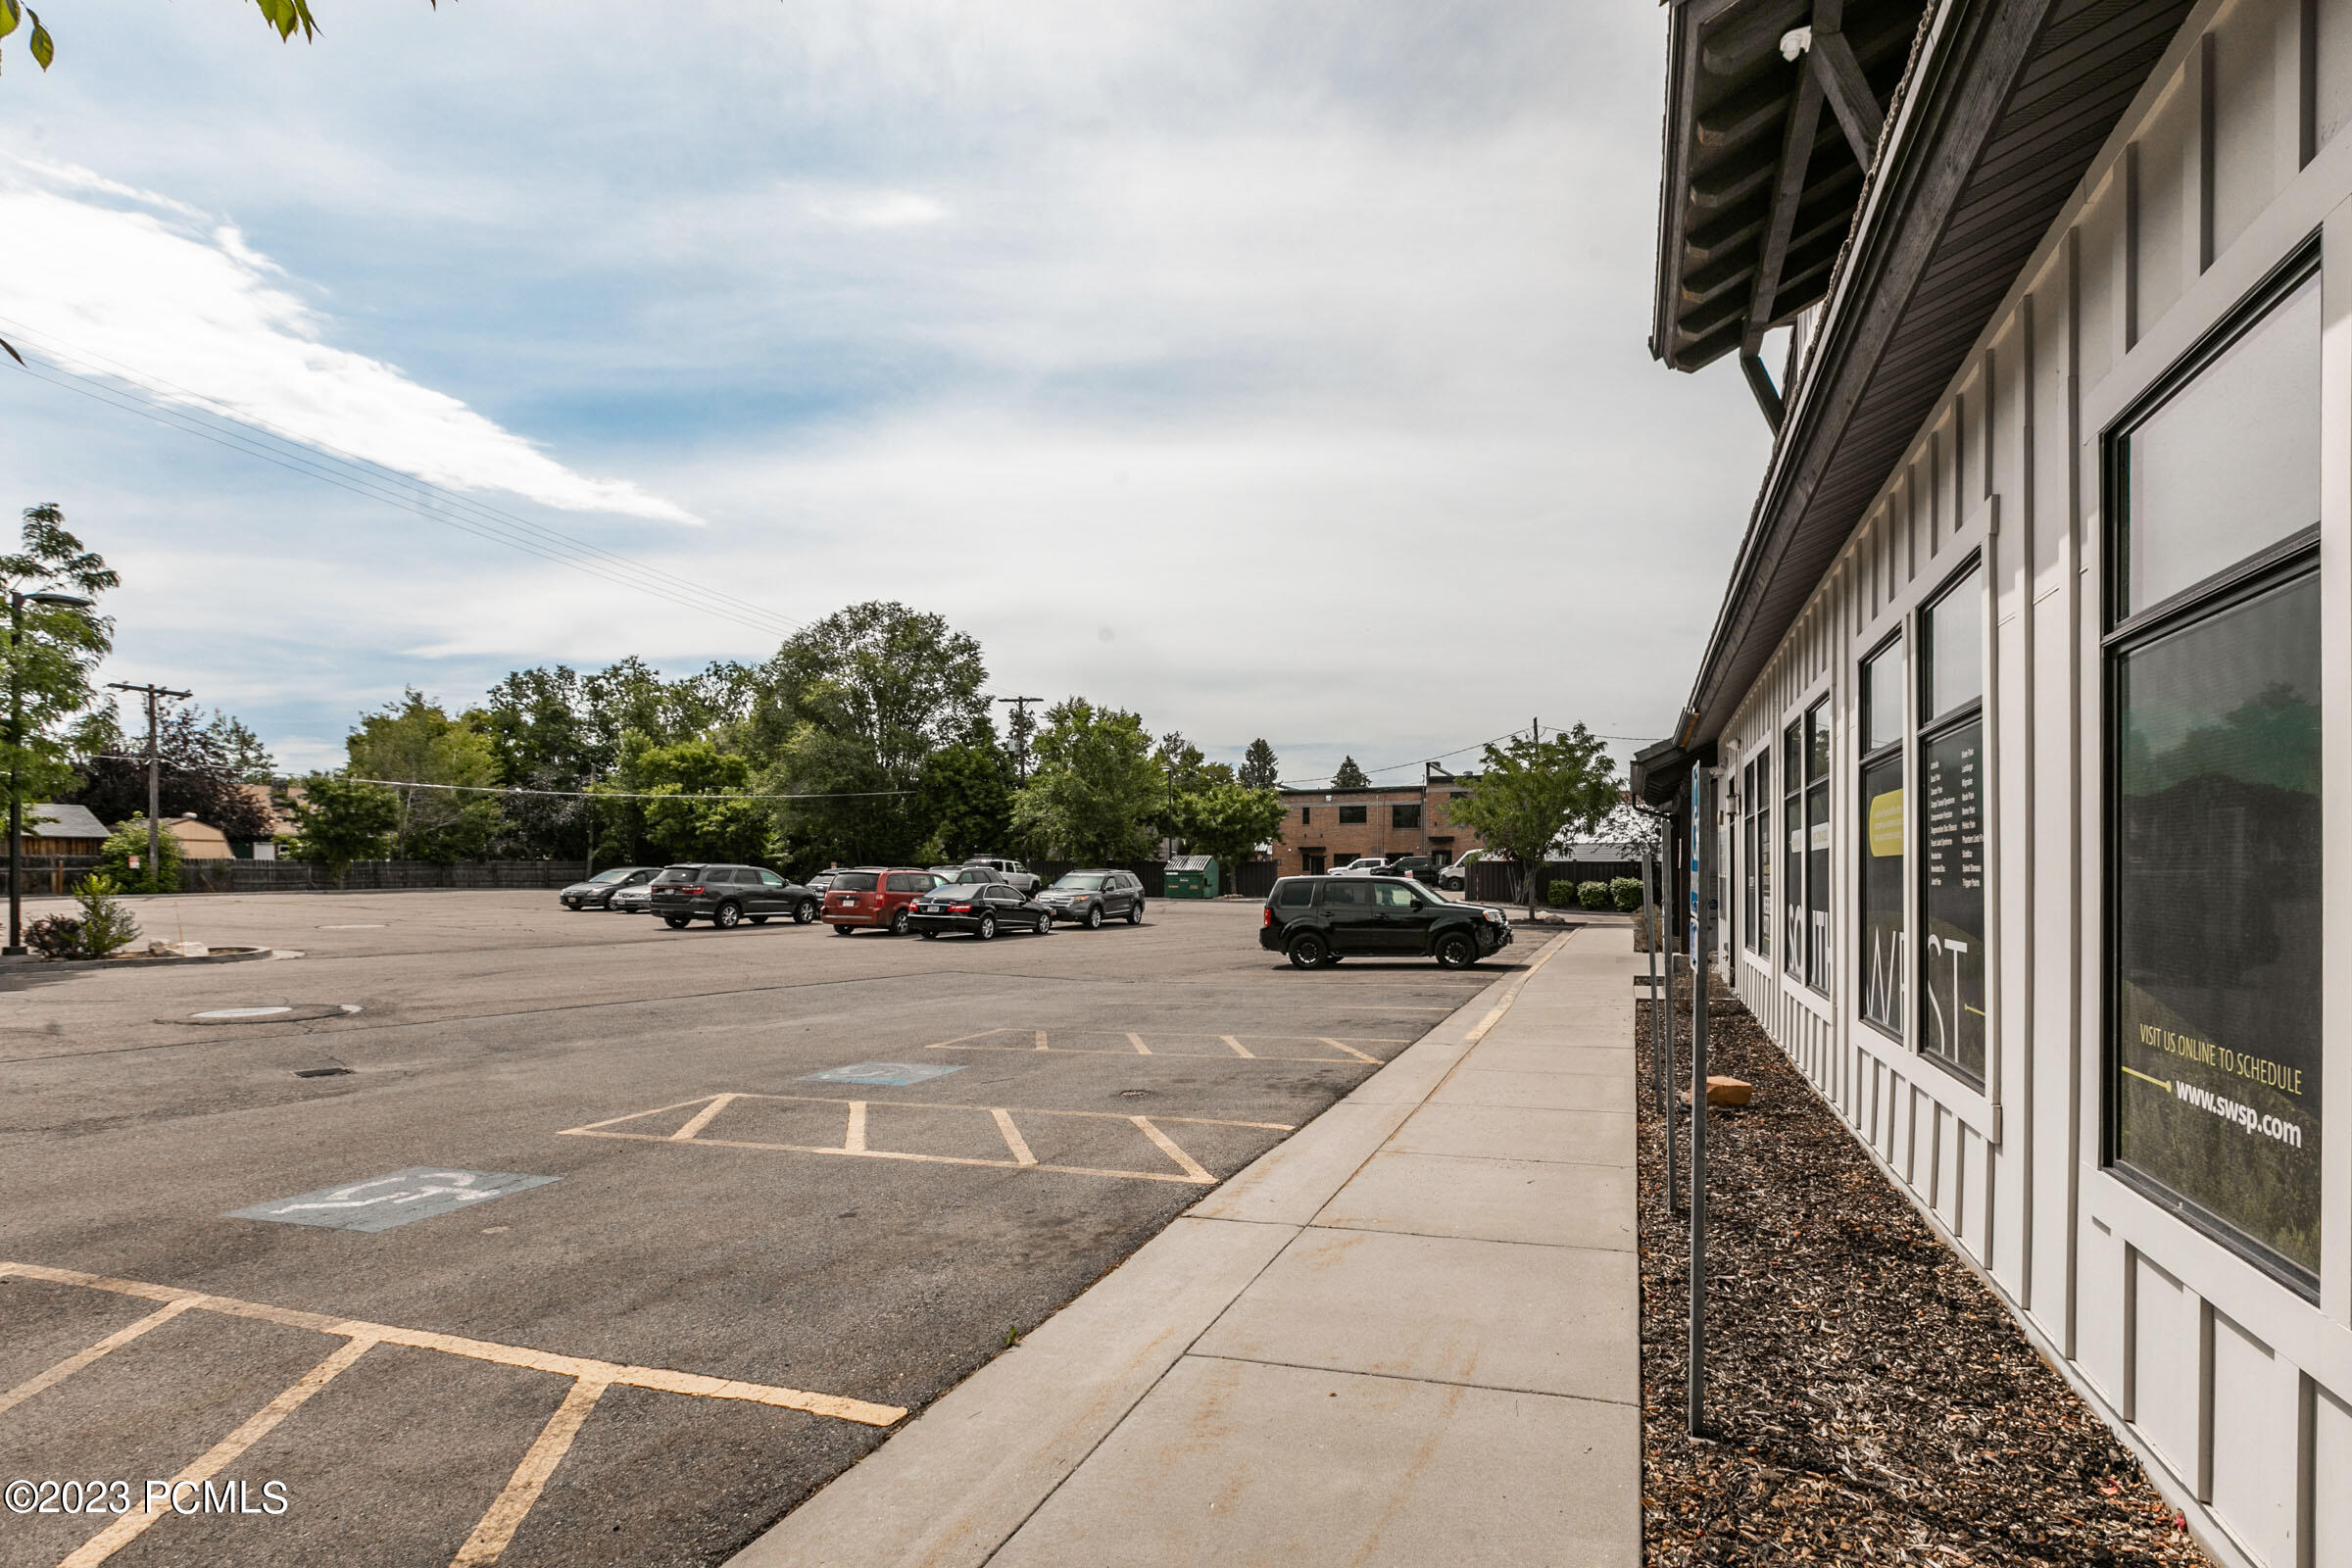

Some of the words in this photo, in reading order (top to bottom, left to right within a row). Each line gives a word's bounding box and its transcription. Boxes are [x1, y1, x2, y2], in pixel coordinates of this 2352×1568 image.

[2139, 1023, 2162, 1048] VISIT
[2164, 1030, 2176, 1053] US
[2179, 1035, 2216, 1066] ONLINE
[2219, 1047, 2233, 1072] TO
[2237, 1053, 2302, 1095] SCHEDULE
[2176, 1080, 2302, 1149] www.swsp.com
